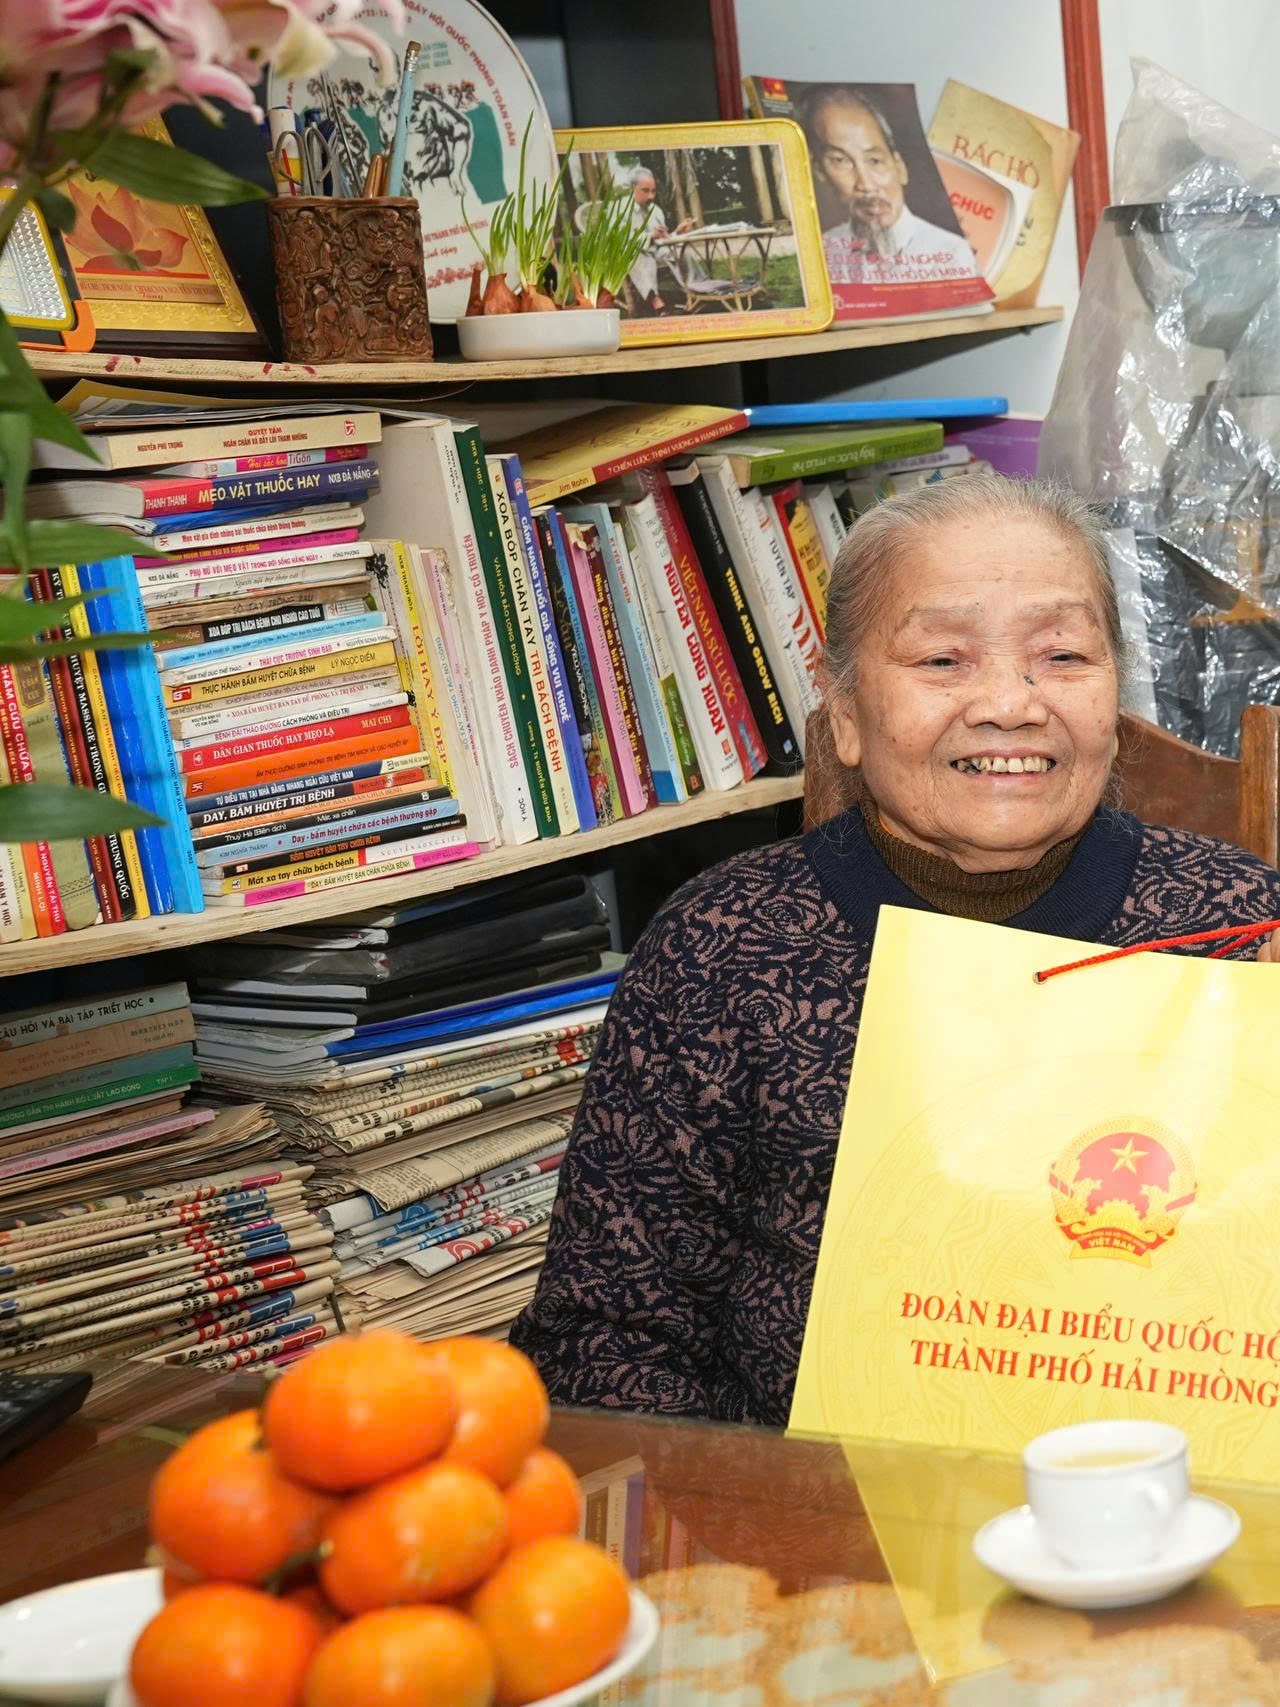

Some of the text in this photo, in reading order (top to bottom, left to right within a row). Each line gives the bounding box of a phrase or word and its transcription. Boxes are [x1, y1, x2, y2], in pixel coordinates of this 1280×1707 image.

[446, 25, 470, 52] QUỐC
[469, 50, 495, 87] PHÒNG
[952, 134, 1041, 189] BÁC HỒ
[144, 494, 188, 509] THANH THANH
[197, 471, 321, 505] MẸO VẶT THUỐC HAY
[557, 476, 589, 493] Jim Rohn
[520, 515, 536, 544] CẨM
[526, 545, 539, 579] NANG
[533, 580, 549, 609] TUỔI
[207, 625, 220, 638] XOA
[270, 615, 281, 626] CHO
[298, 609, 309, 620] CAO
[493, 556, 522, 675] VĂN HÓA BẢO LONG ĐƯỜNG
[496, 491, 564, 772] XOA BÓP CHÂN TAY TRỊ BÁCH BỆNH
[539, 610, 552, 631] GIÀ
[329, 650, 375, 668] LÝ NGỌC ĐIỂM
[461, 533, 518, 768] SÁCH CHUYÊN KHẢO DANH PHÁP Y HỌC CỔ TRUYỀN
[544, 632, 561, 666] SỐNG
[662, 562, 726, 735] NGUYỄN CÔNG HOAN
[723, 568, 785, 725] THINK AND GROW RICH
[200, 662, 316, 695] THỰC HÀNH BẤM HUYỆT CHỮA BỆNH
[412, 624, 447, 764] LỜI HAY Ý ĐẸP
[551, 667, 562, 688] VUI
[69, 653, 103, 780] HUYỆT MASSAGE TRONG
[360, 714, 392, 728] MAI CHI
[7, 701, 21, 729] CỨU
[14, 732, 30, 770] CHỮA
[212, 726, 335, 759] DÂN GIAN THUỐC HAY MẸO LẠ
[202, 810, 228, 824] DAY,
[228, 802, 253, 818] BẤM
[252, 795, 288, 813] HUYỆT
[288, 794, 306, 807] TRỊ
[306, 786, 335, 803] BỆNH
[291, 833, 305, 844] Day
[326, 824, 347, 837] huyệt
[347, 820, 366, 831] chữa
[366, 817, 380, 827] các
[380, 814, 399, 825] bệnh
[398, 809, 423, 822] thường
[424, 806, 438, 817] gặp
[107, 833, 122, 868] TRUNG
[32, 871, 43, 894] MINH
[114, 869, 131, 899] QUỐC
[246, 856, 354, 886] Mát xa tay chữa bách bệnh
[41, 856, 60, 922] NGUYỄN TÀI THU
[97, 1000, 121, 1016] TRIẾT
[123, 997, 144, 1011] HỌC
[1112, 1238, 1136, 1252] NAM
[901, 1290, 990, 1326] ĐOÀN
[996, 1302, 1052, 1339] ĐẠI
[1060, 1303, 1134, 1343] BIỂU
[1141, 1316, 1235, 1355] QUỐC
[910, 1338, 1280, 1408] THÀNH PHỐ HẢI PHÒNG
